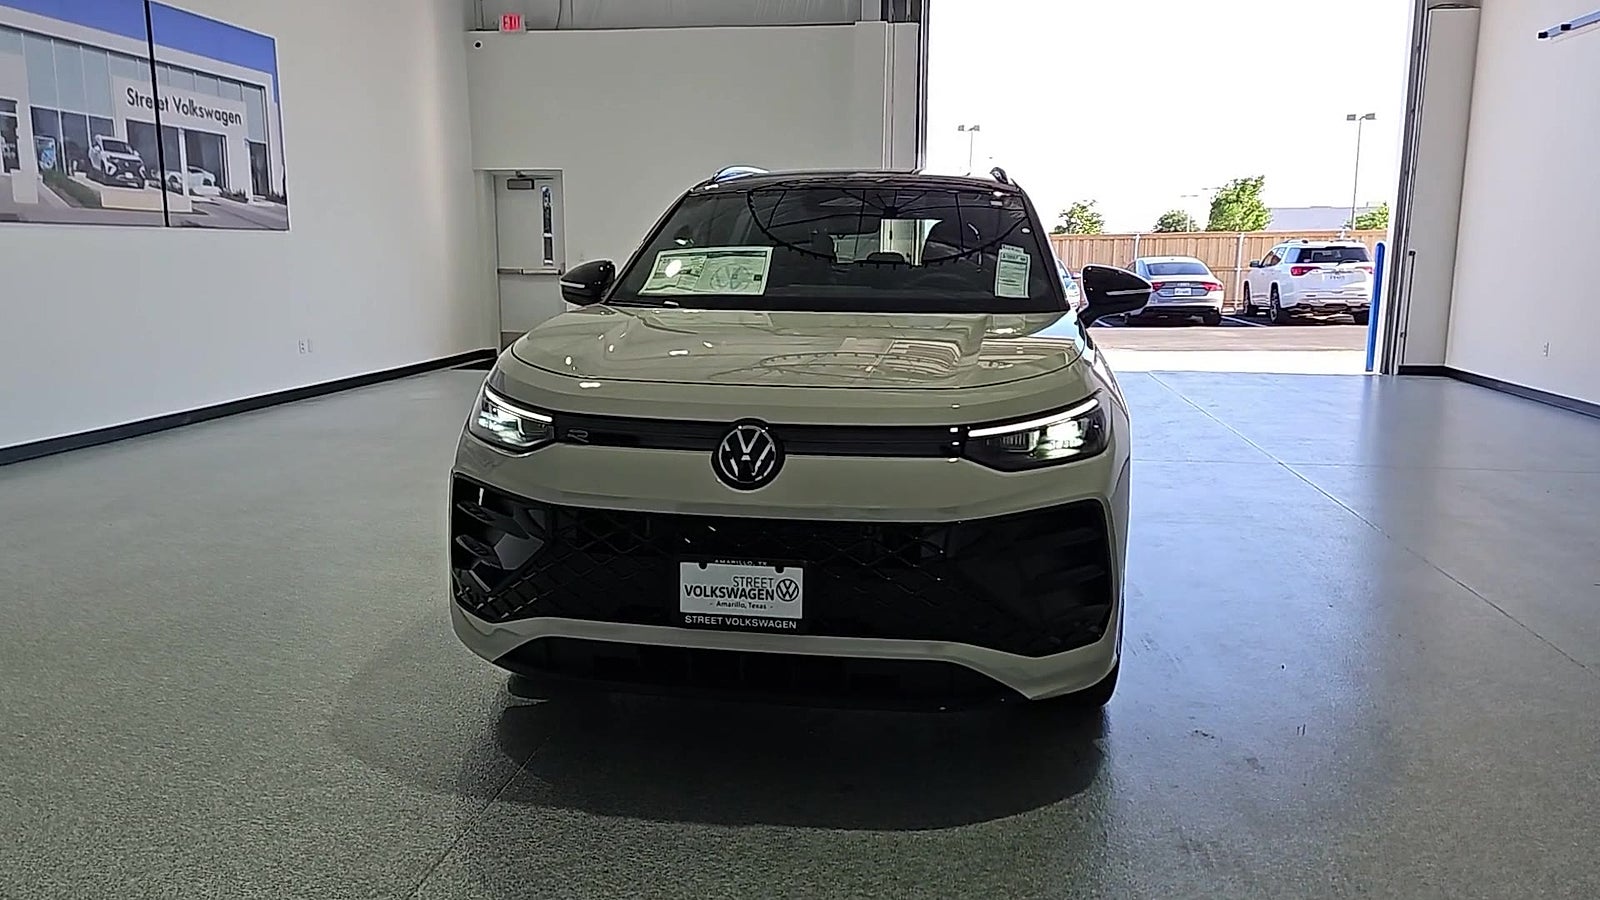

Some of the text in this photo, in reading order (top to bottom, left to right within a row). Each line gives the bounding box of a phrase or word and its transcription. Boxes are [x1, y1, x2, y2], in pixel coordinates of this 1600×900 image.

[503, 15, 521, 30] EXIT
[126, 87, 242, 127] Street Volkswagen
[732, 576, 775, 589] STREET
[684, 584, 775, 601] VOLKSWAGEN
[715, 600, 767, 610] Amarillo, Texas
[684, 614, 797, 629] STREET VOLKSWAGEN
